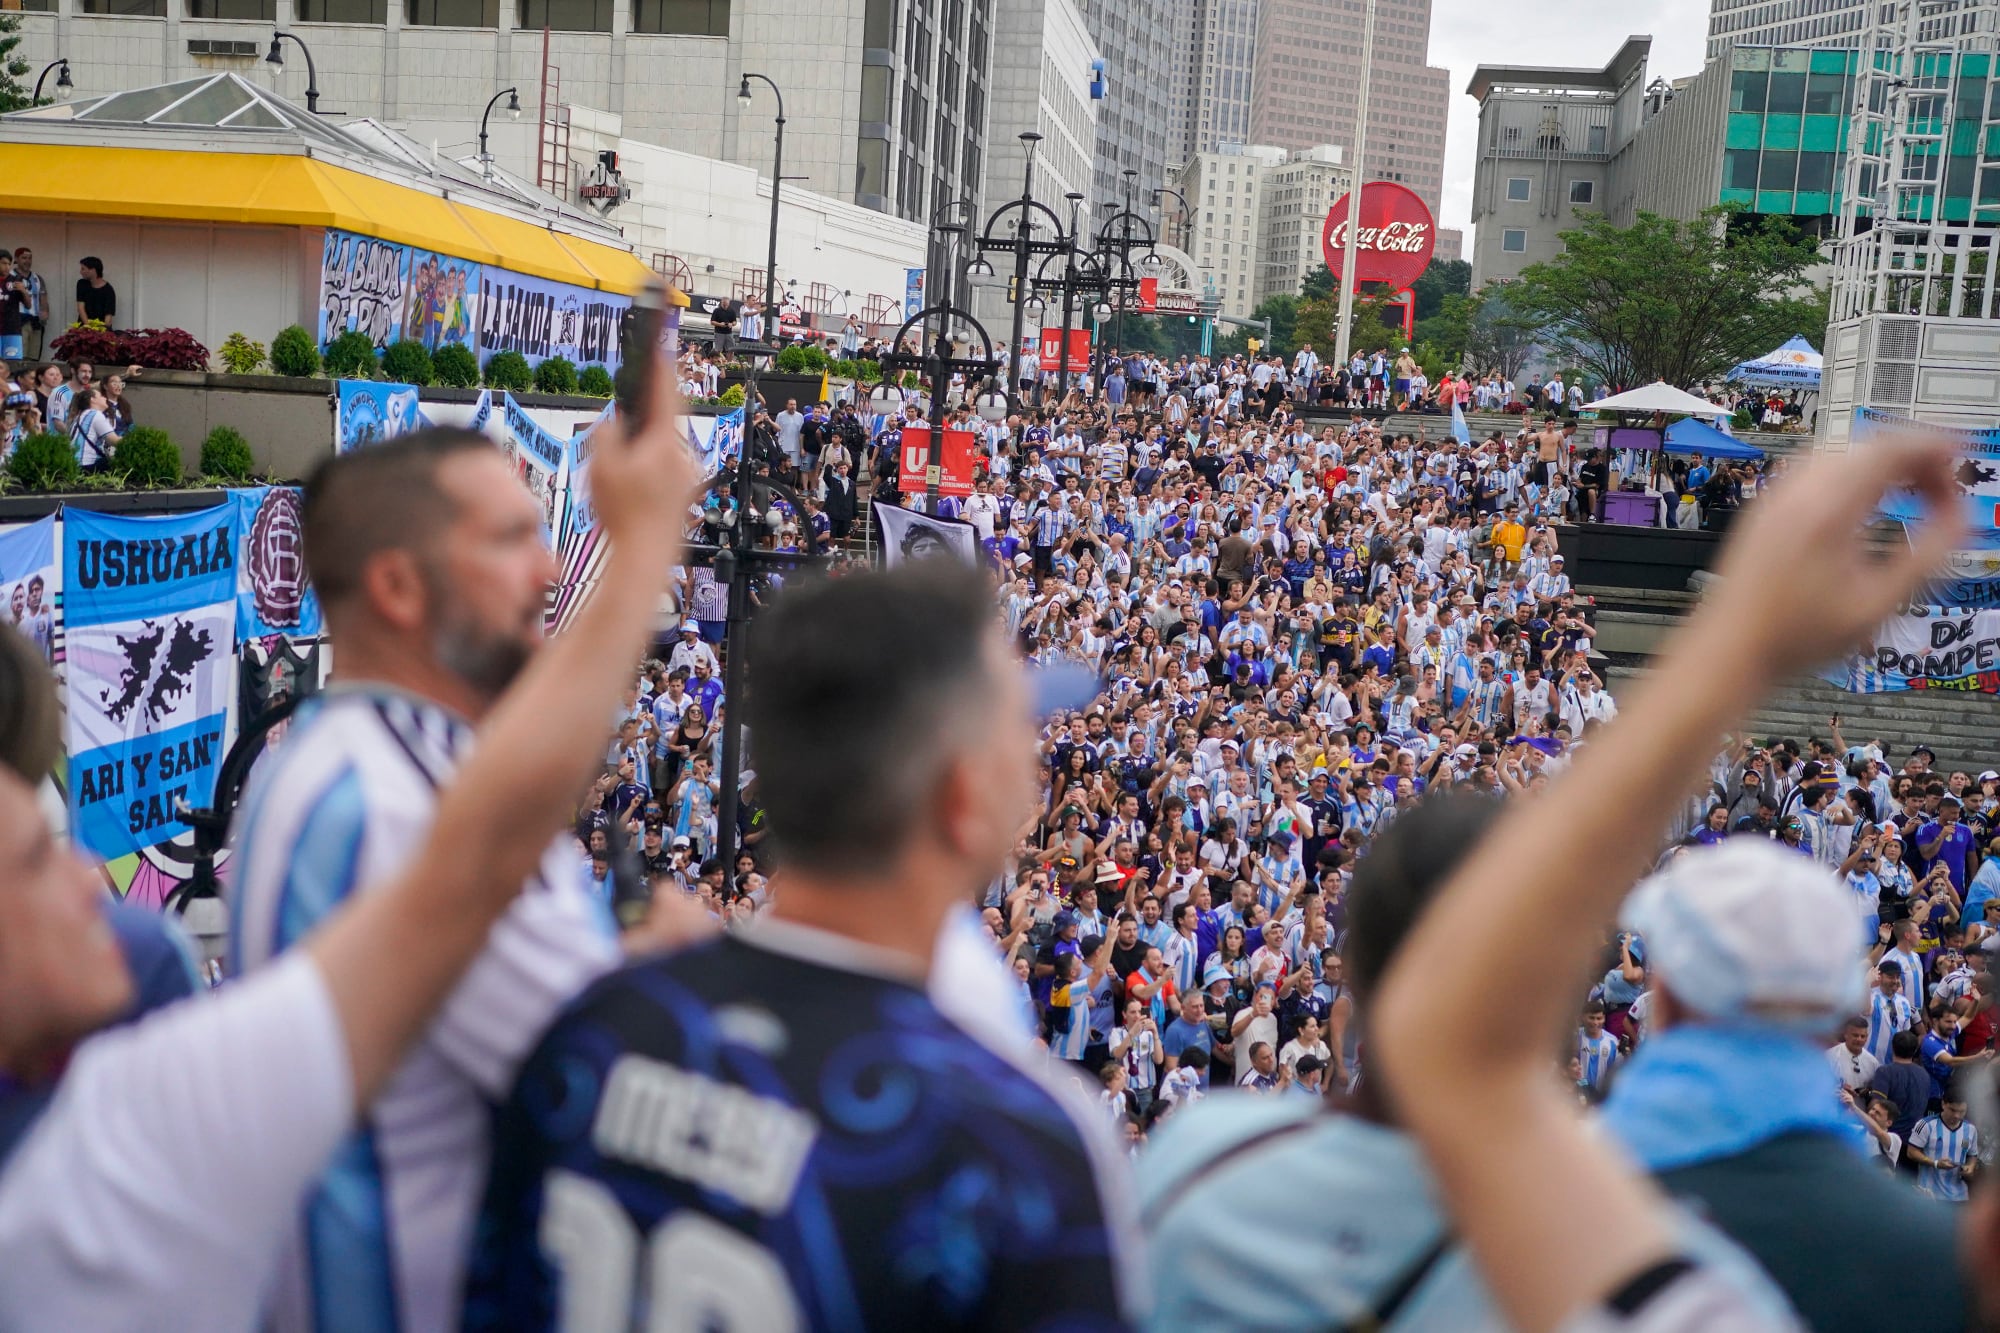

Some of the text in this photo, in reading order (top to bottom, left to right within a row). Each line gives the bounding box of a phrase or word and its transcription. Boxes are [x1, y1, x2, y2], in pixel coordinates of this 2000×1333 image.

[325, 234, 402, 300] LA BANDA
[481, 279, 503, 350] LA
[501, 285, 555, 358] BANDA
[579, 302, 614, 363] NEW
[1781, 370, 1808, 378] CATERING
[906, 446, 928, 472] U
[78, 526, 232, 590] USHUAIA
[1931, 616, 1974, 649] DE
[79, 760, 125, 807] ARI
[131, 754, 153, 789] Y
[594, 1050, 820, 1217] MESSI
